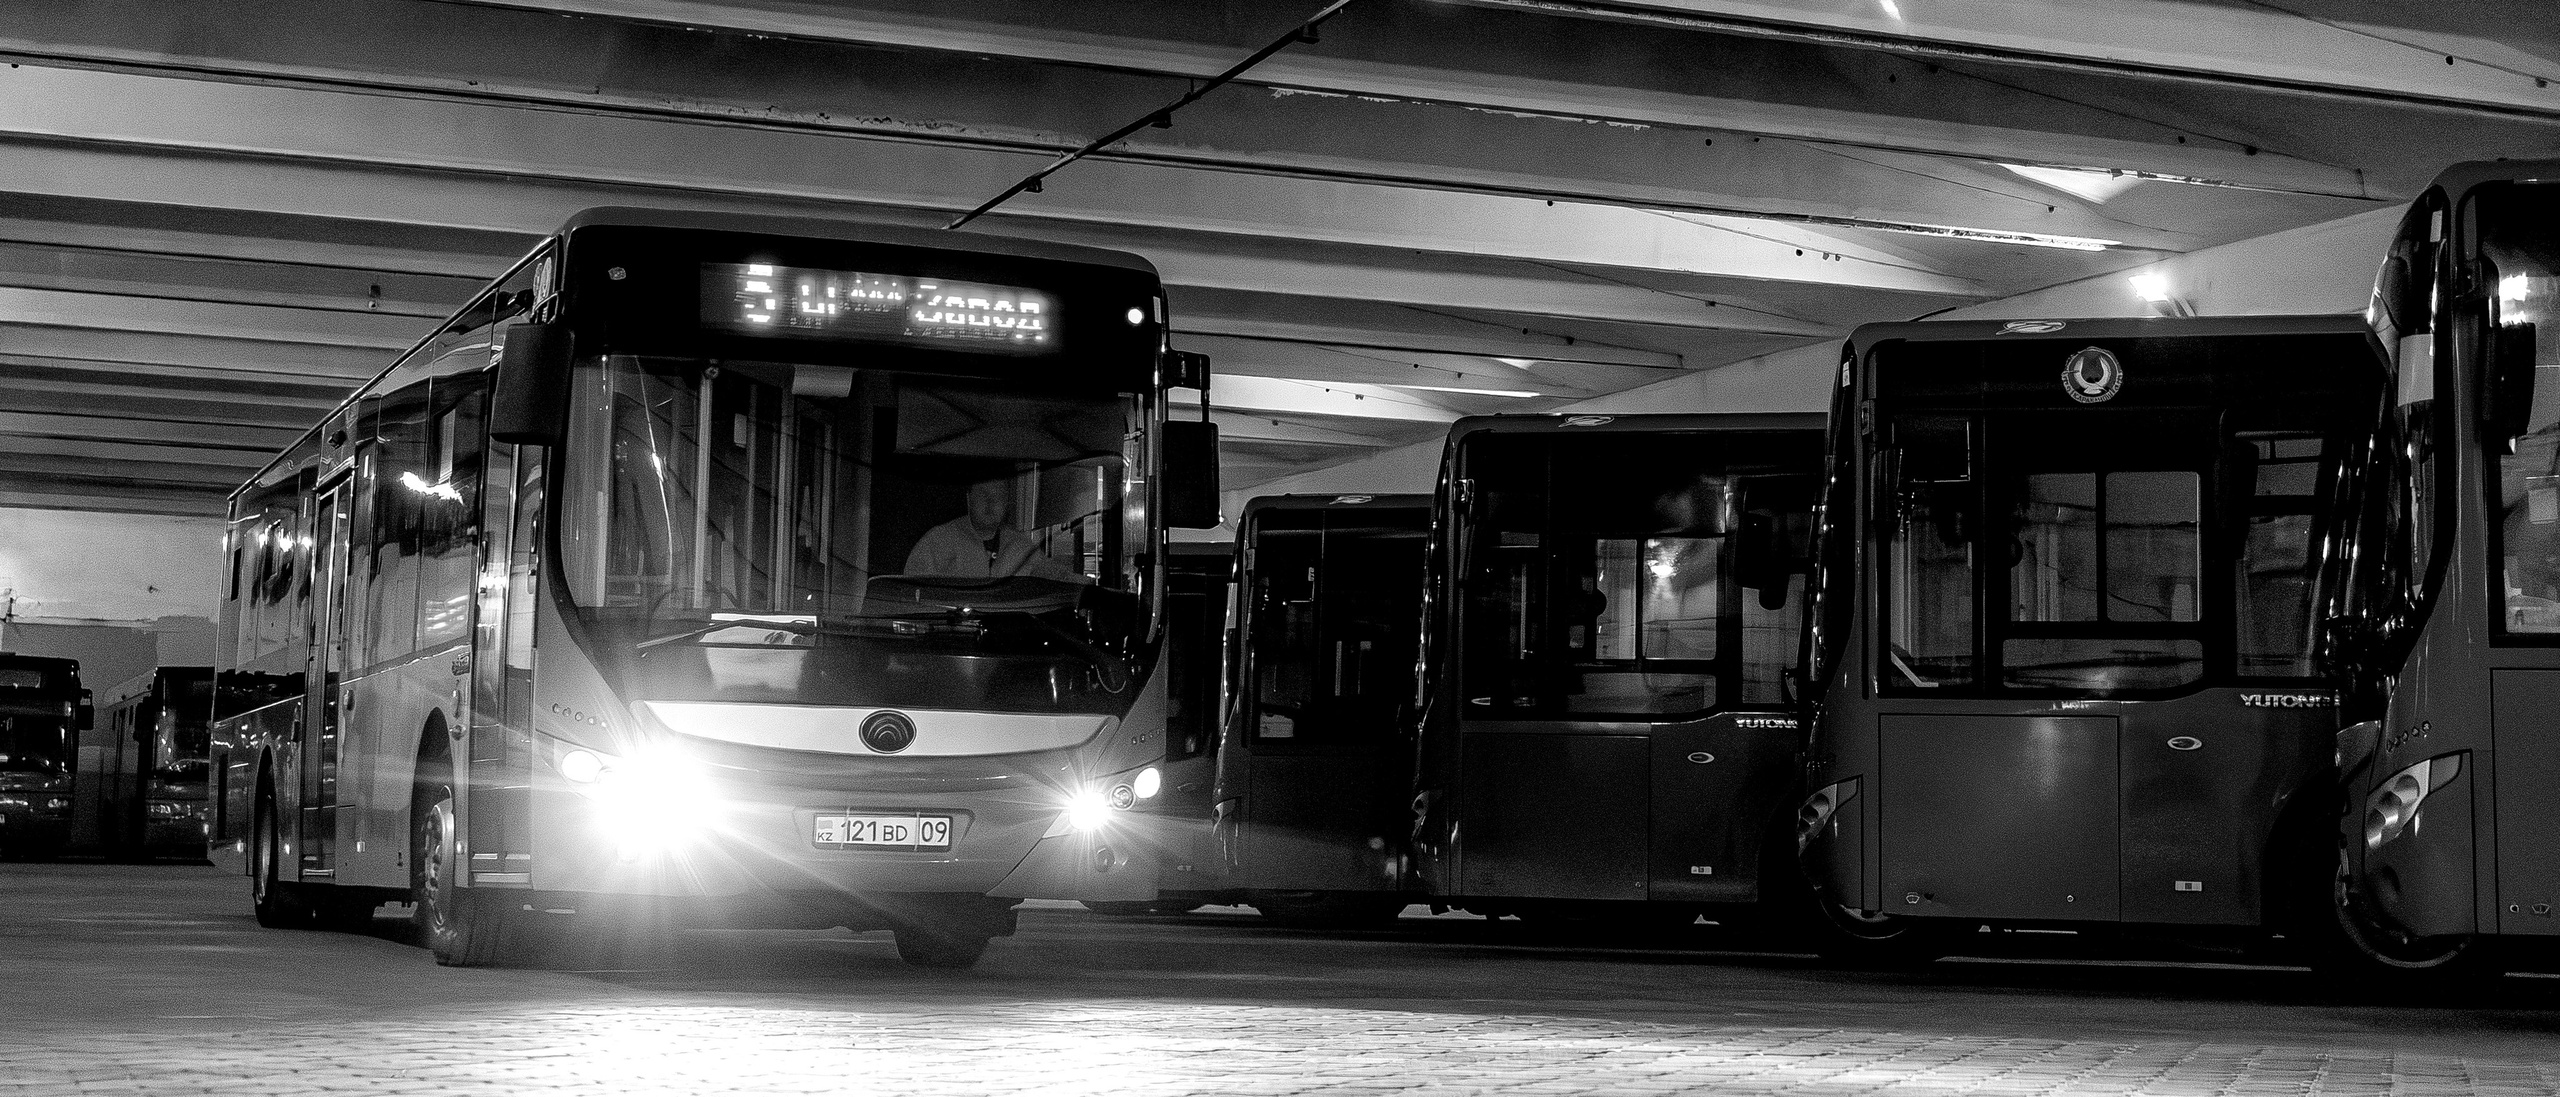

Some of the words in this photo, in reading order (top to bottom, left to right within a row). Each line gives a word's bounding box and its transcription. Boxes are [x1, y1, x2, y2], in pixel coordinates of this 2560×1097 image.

[817, 832, 833, 842] KZ
[840, 820, 877, 842] 121
[883, 825, 908, 842] BD
[921, 820, 948, 843] 09
